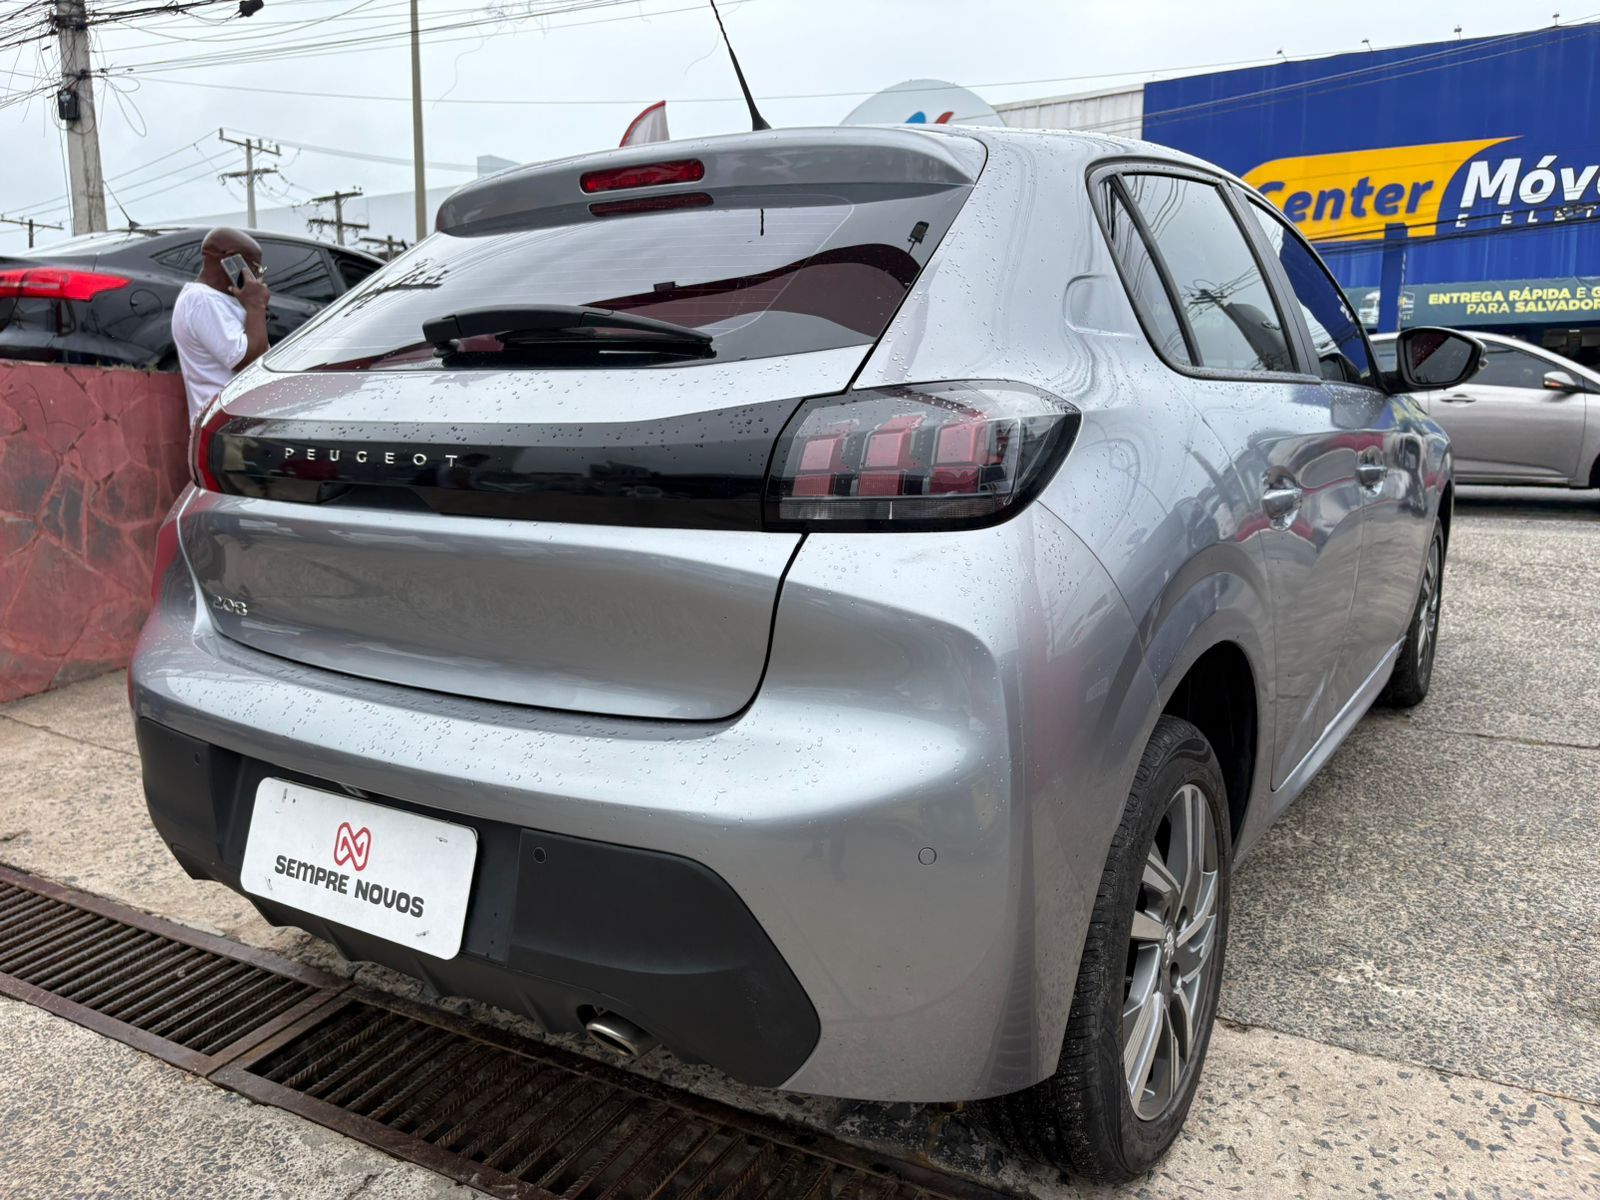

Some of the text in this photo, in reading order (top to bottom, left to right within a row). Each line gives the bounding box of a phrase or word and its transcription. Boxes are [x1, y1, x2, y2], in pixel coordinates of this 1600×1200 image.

[1460, 155, 1600, 208] Móv
[1428, 290, 1504, 305] ENTREGA
[1508, 286, 1571, 301] RÁPIDA
[1576, 286, 1587, 299] E
[1466, 302, 1510, 315] PARA
[284, 447, 458, 468] PEUGEOT
[274, 854, 425, 918] SEMPRE NOVOS
